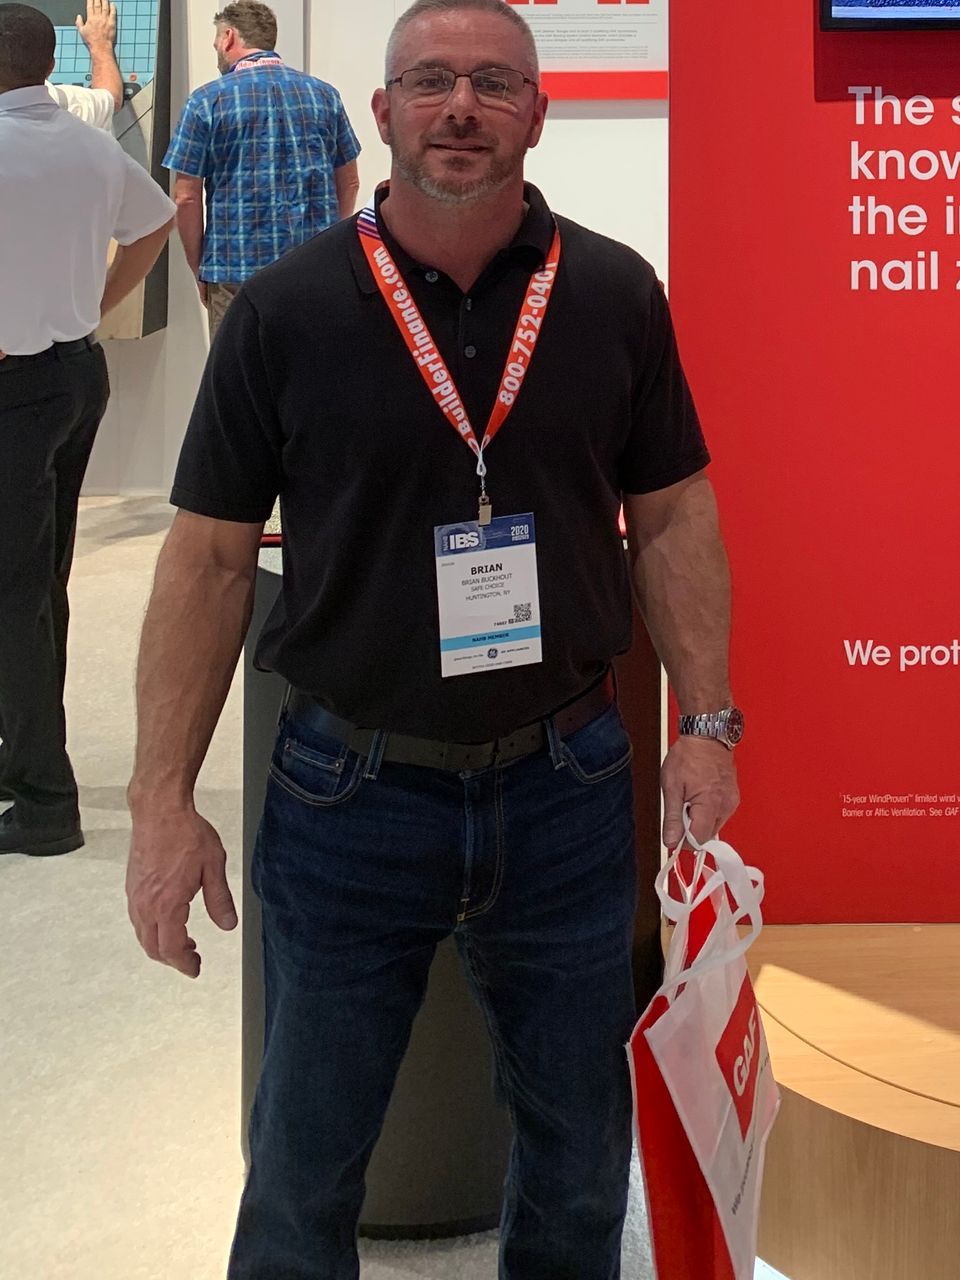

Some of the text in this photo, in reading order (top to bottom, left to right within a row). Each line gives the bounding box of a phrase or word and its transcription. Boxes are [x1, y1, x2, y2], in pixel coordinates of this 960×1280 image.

[848, 86, 935, 125] The
[848, 196, 928, 236] the
[850, 251, 939, 290] nail
[372, 246, 471, 435] BuilderFinance.com
[510, 524, 529, 536] 2020
[449, 531, 480, 550] IBS
[470, 563, 503, 576] BRIAN
[461, 576, 480, 586] BRIAN
[843, 639, 891, 666] We
[914, 793, 938, 803] limited
[939, 793, 956, 803] wind
[842, 808, 864, 817] Barrier
[865, 809, 873, 817] or
[874, 808, 890, 817] Attic
[929, 807, 943, 817] See
[944, 807, 958, 816] GAF
